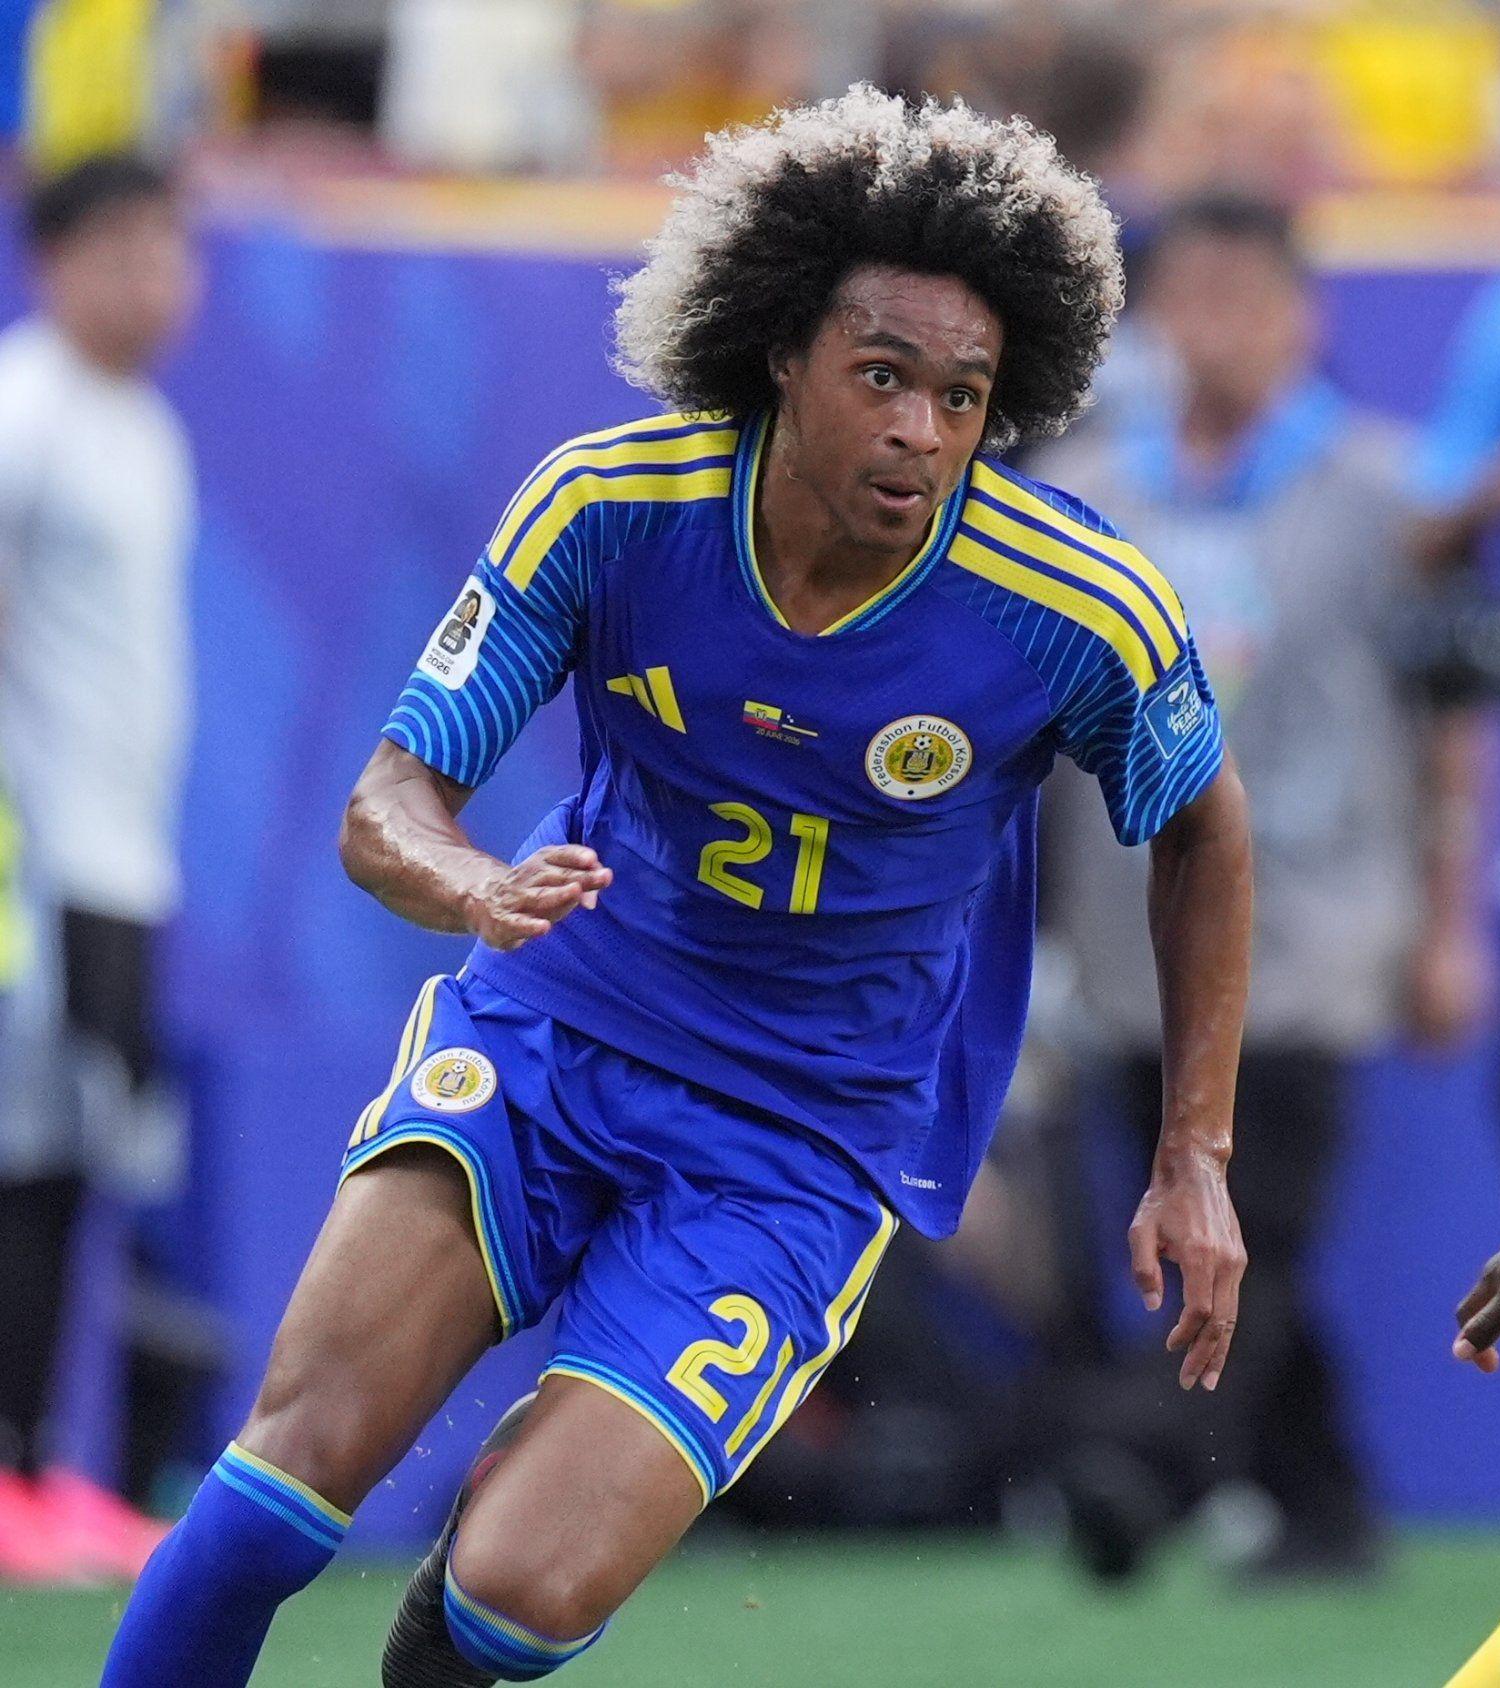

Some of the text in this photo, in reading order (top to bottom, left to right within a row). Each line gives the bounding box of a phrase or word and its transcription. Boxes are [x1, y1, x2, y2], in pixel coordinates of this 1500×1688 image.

[426, 654, 451, 676] 2026
[872, 724, 912, 788] Federashon
[697, 801, 830, 915] 21
[664, 1293, 795, 1460] 21
